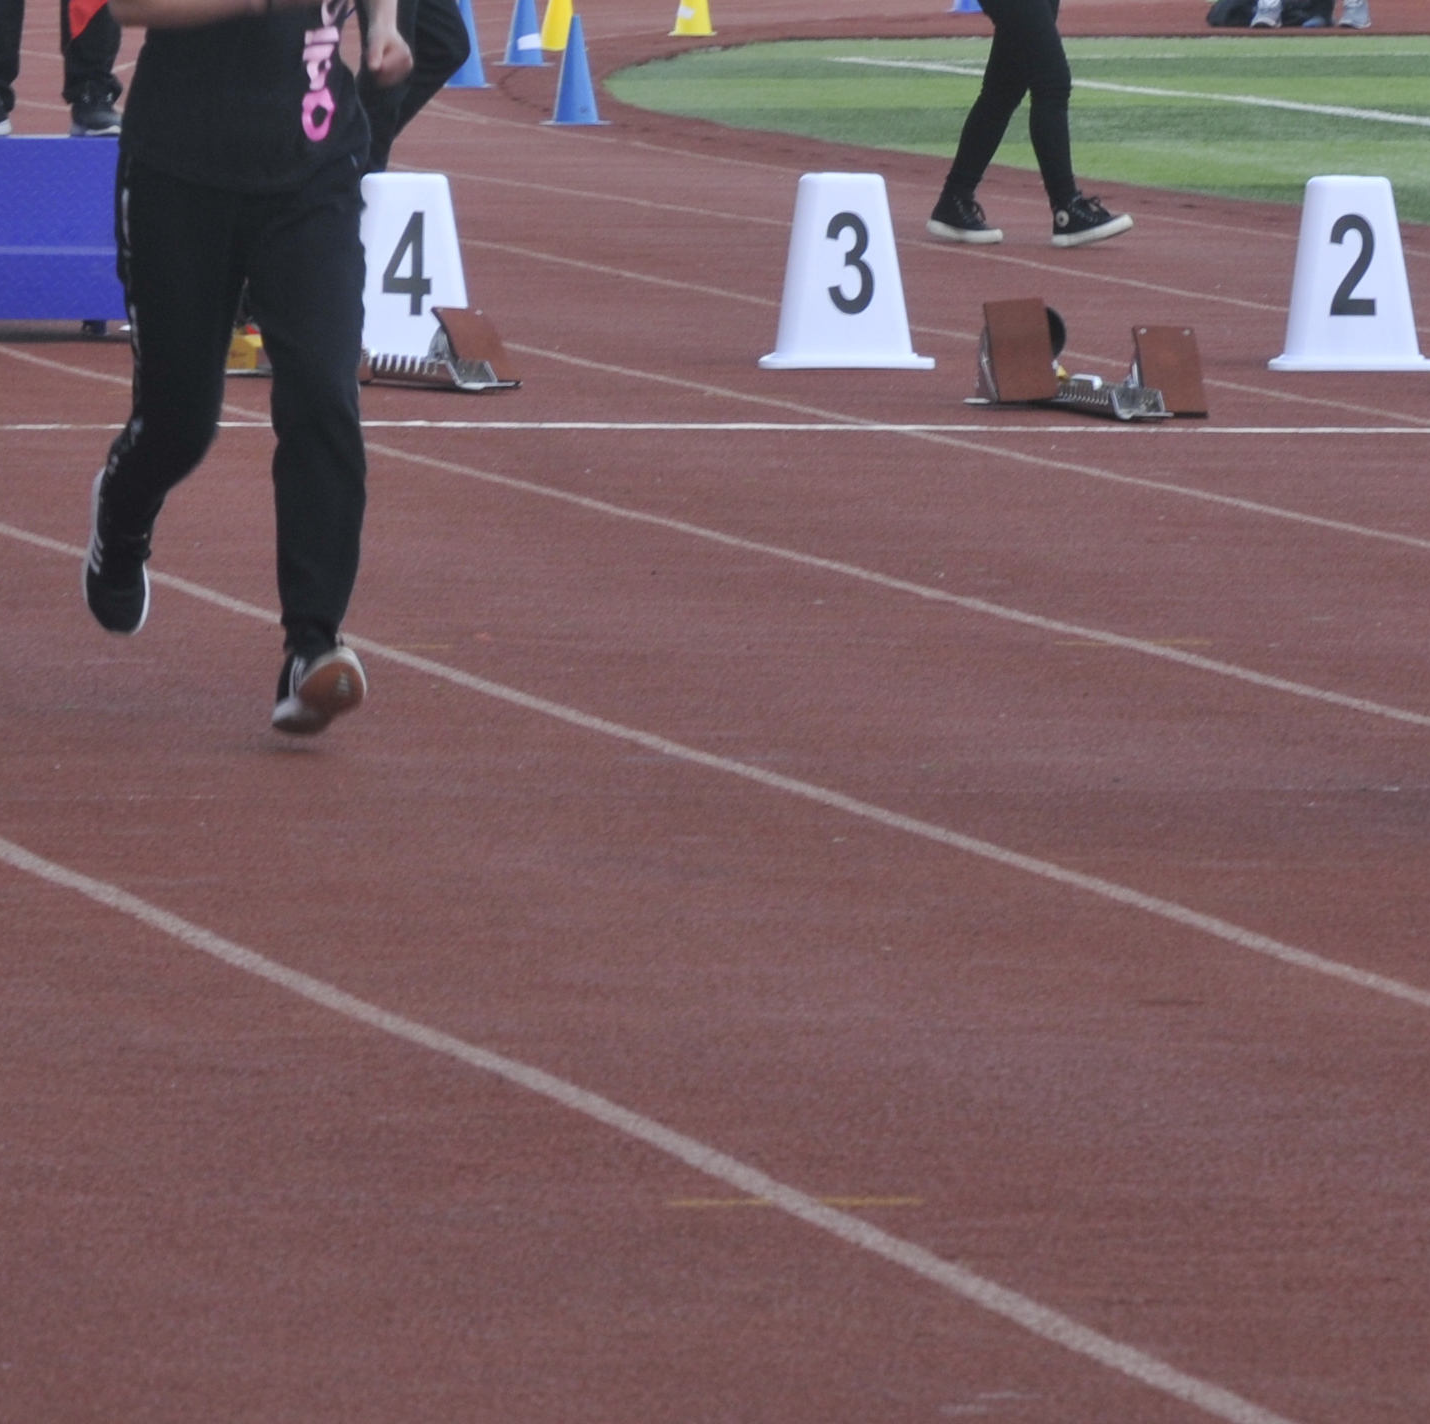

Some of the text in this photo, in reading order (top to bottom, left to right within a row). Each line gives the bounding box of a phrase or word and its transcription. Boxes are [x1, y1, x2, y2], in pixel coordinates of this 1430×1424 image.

[382, 211, 432, 316] 4
[825, 211, 876, 315] 3
[1329, 213, 1377, 317] 2
